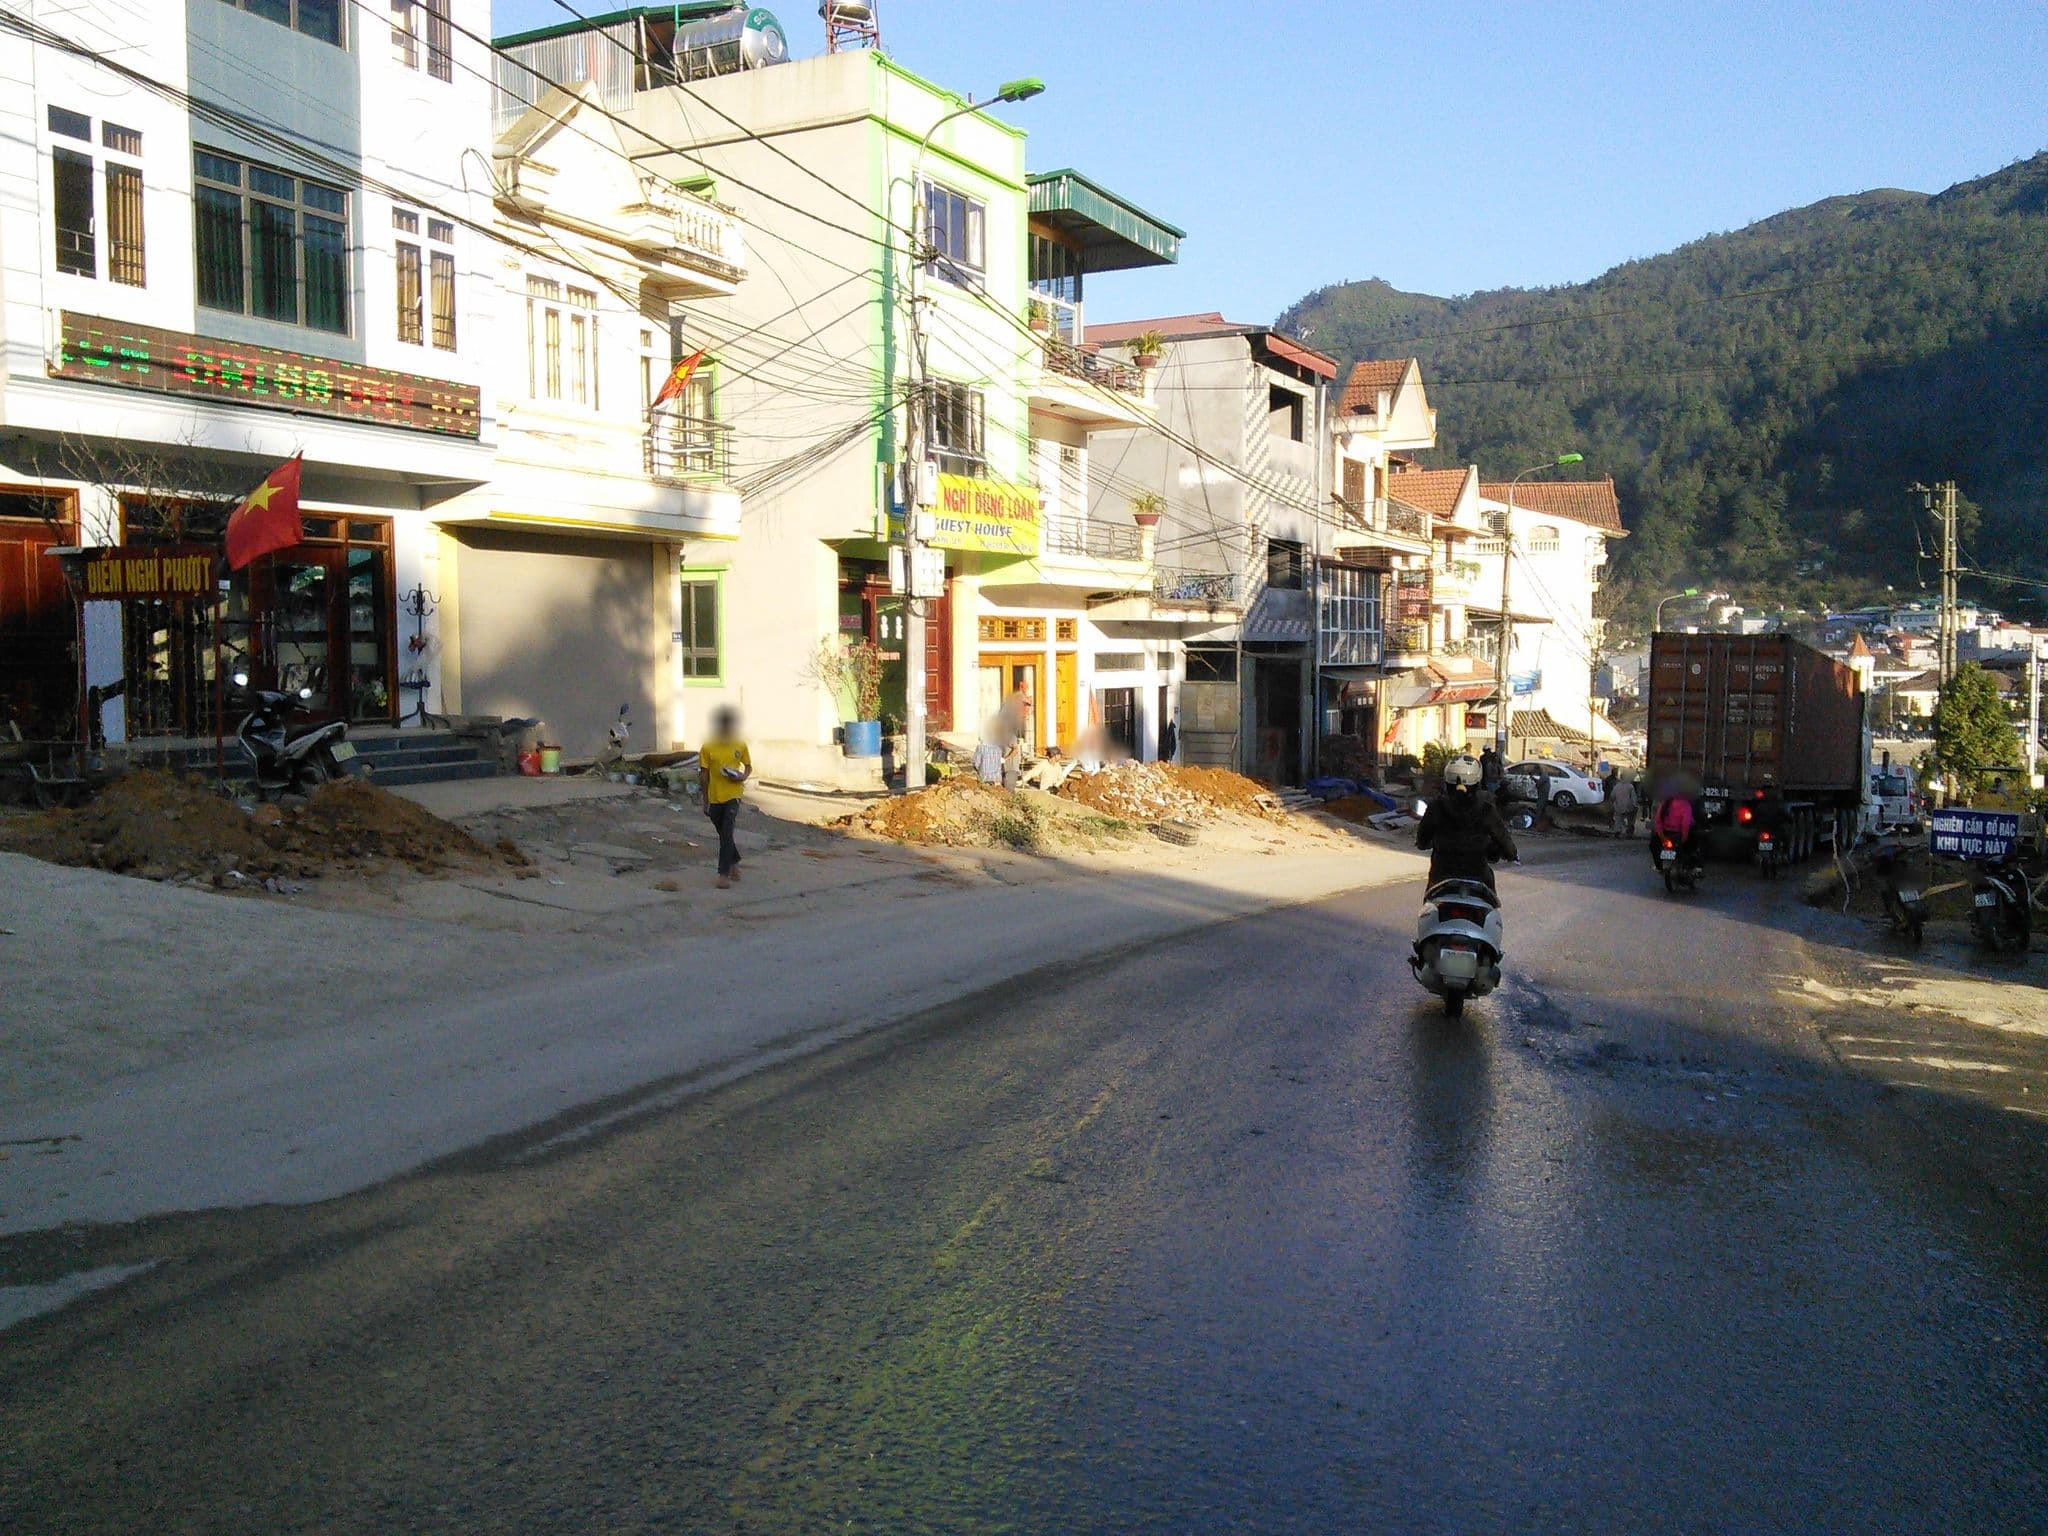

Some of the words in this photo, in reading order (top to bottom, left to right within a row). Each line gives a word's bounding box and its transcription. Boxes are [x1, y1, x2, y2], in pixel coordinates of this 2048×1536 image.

[1008, 498, 1036, 522] LOAN
[974, 522, 1013, 537] HOUSE
[125, 547, 160, 593] NGHỈ
[163, 554, 212, 597] PHƯỢT
[1932, 815, 1964, 833] NGHIÊM
[1964, 815, 1983, 835] CẤM
[1999, 820, 2016, 837] RÁC
[1936, 835, 1959, 851] KHU
[1961, 836, 1983, 855] VỰC
[1985, 837, 2008, 855] NÀY
